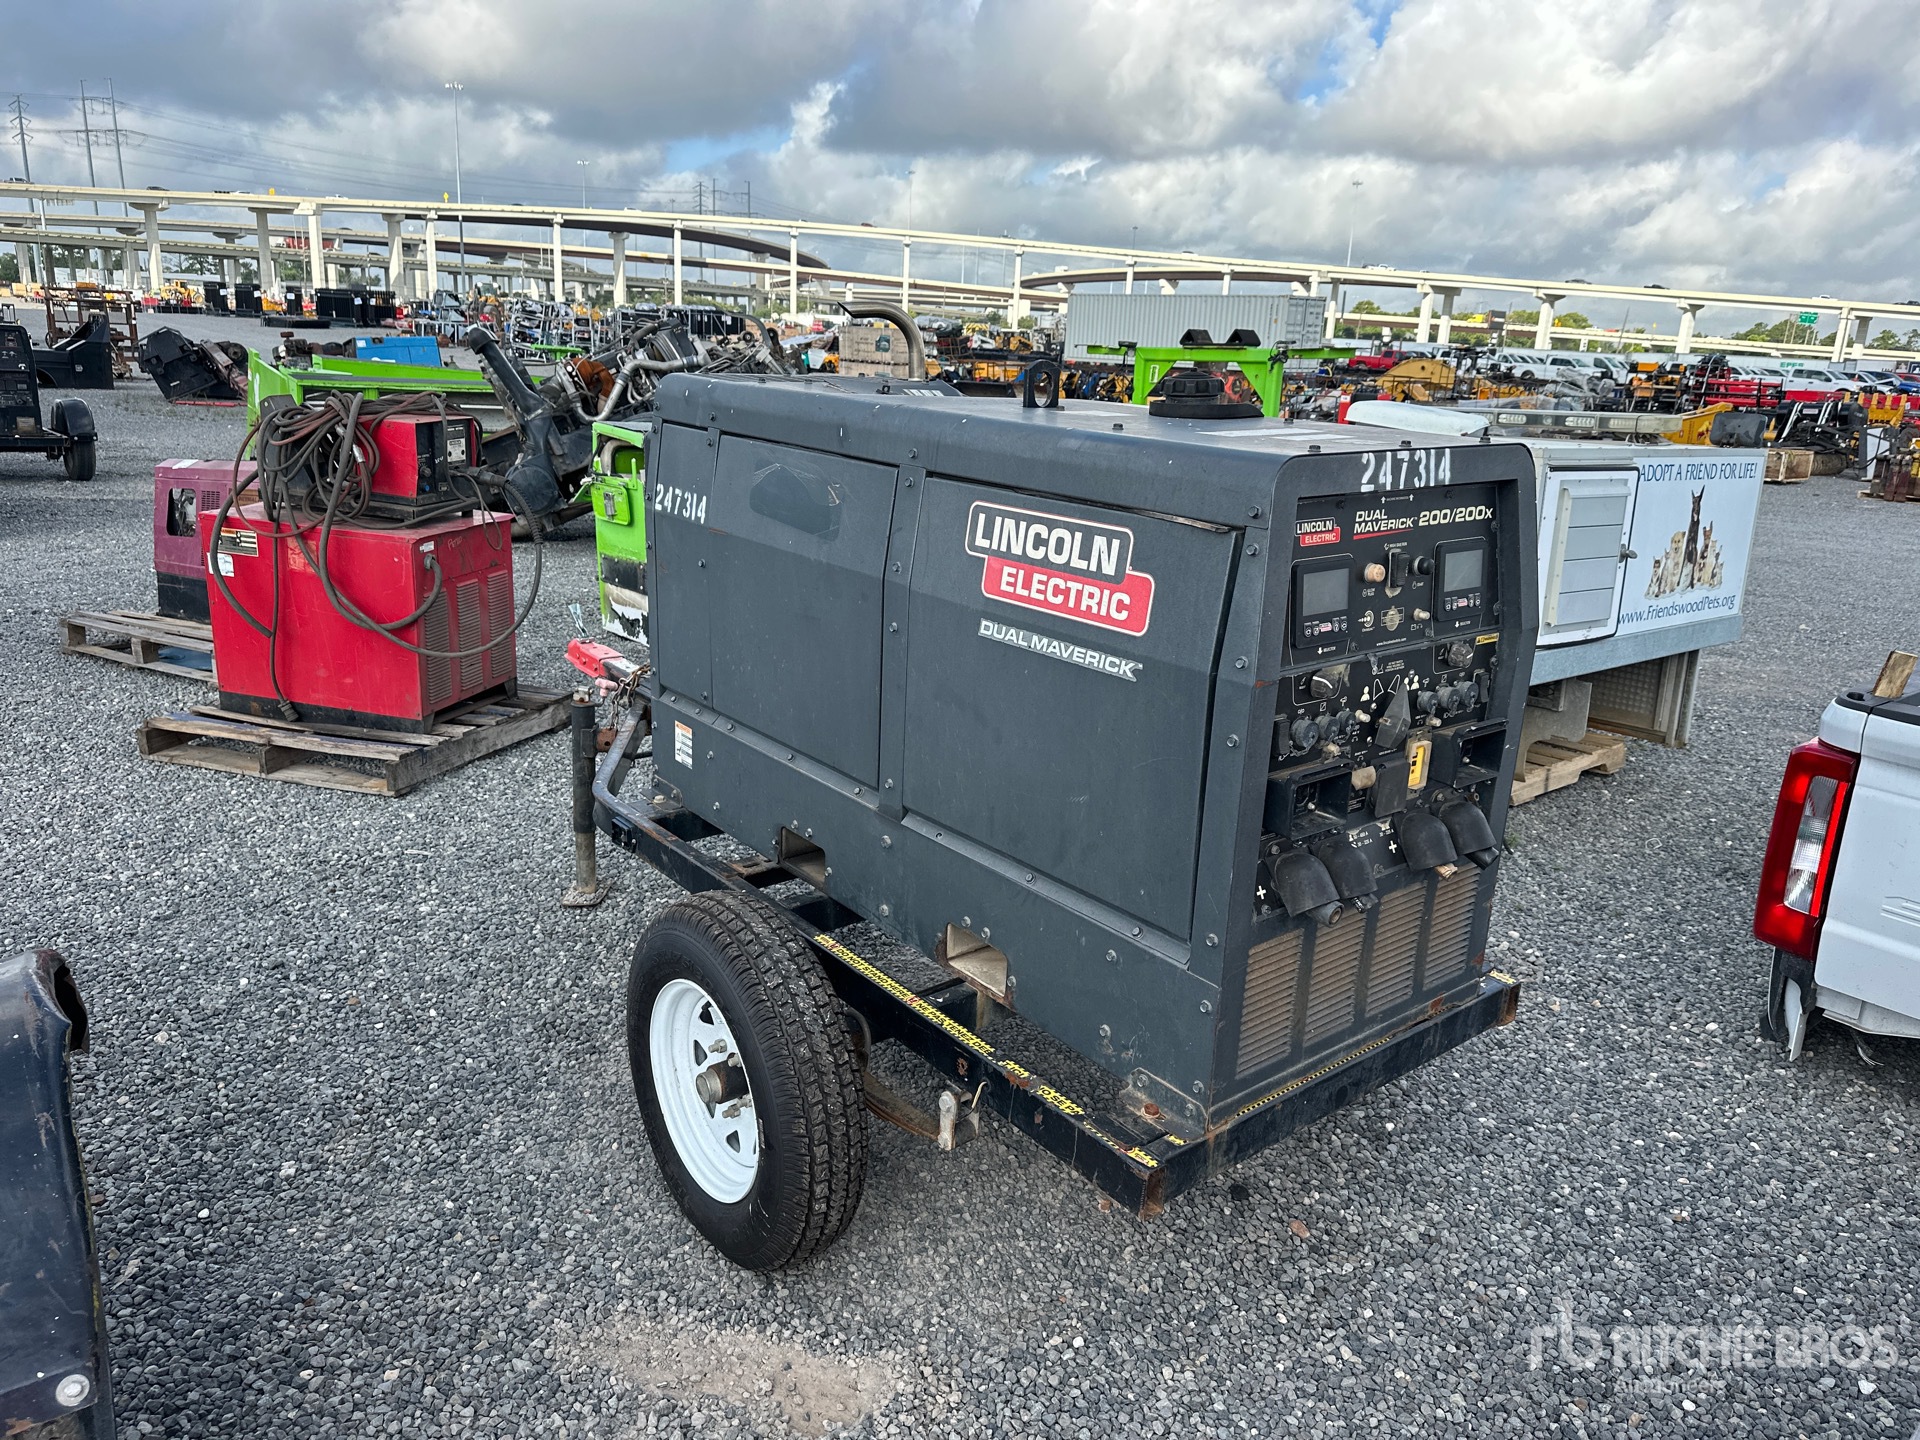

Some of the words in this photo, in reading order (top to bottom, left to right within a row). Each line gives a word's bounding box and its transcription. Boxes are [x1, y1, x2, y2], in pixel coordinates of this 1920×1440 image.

[1360, 448, 1452, 492] 247314
[1640, 464, 1675, 482] ADOPT
[1676, 464, 1684, 481] A
[1685, 463, 1717, 480] FRIEND
[1720, 463, 1737, 479] FOR
[1738, 462, 1758, 479] LIFE!
[655, 483, 708, 524] 247314
[1355, 508, 1388, 522] DUAL
[1296, 519, 1334, 535] LINCOLN
[1304, 532, 1337, 544] ELECTRIC
[1354, 517, 1415, 534] MAVERICK
[975, 512, 1121, 576] LINCOLN
[1000, 565, 1131, 621] ELECTRIC
[1618, 594, 1736, 626] www.FriendswoodPets.org
[979, 620, 1029, 647] DUAL
[849, 956, 865, 968] NOT
[863, 966, 889, 984] STAND
[888, 981, 910, 998] HERE
[916, 1003, 930, 1011] NE
[928, 1011, 946, 1024] PAS
[946, 1023, 974, 1042] TENEZ
[1051, 1095, 1066, 1106] SE
